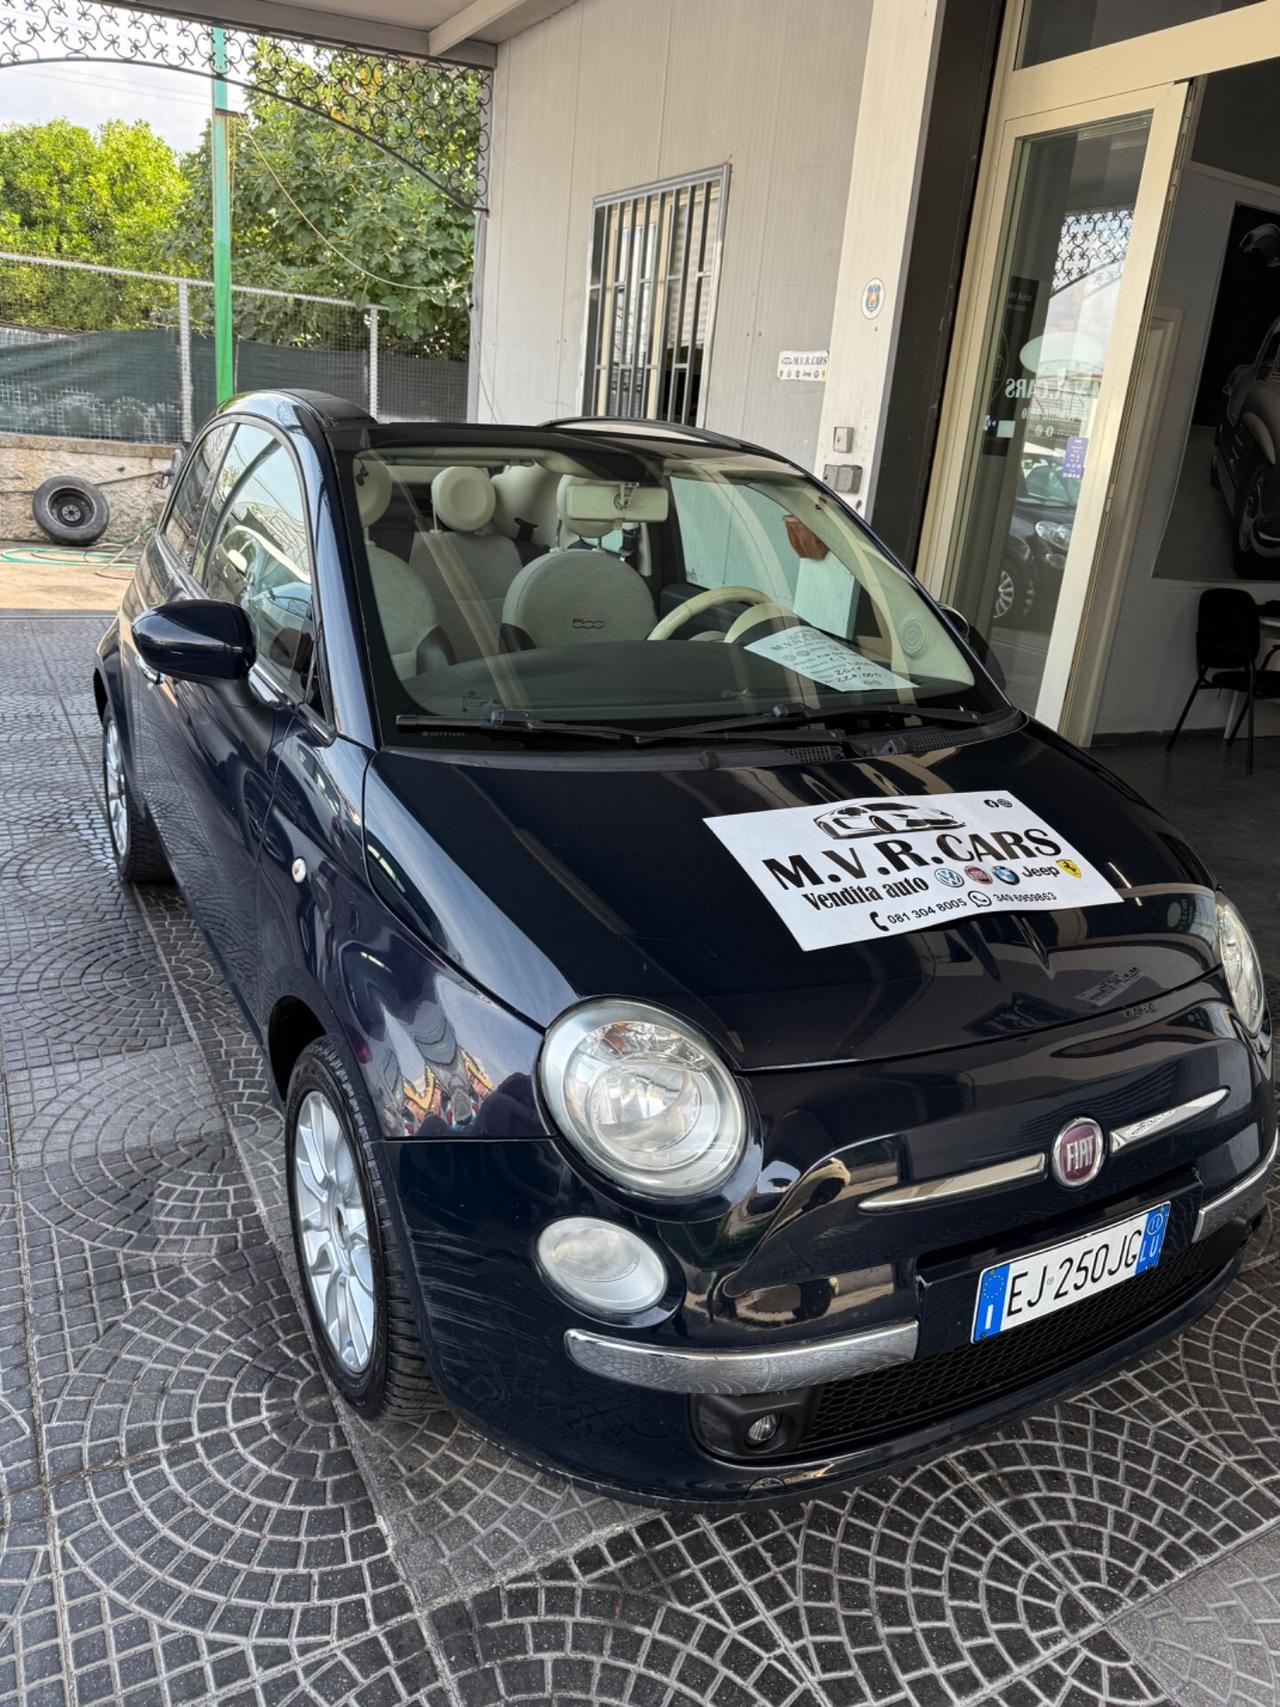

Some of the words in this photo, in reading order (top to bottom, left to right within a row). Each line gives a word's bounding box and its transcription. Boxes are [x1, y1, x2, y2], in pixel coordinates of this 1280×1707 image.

[1021, 865, 1060, 877] Jeep
[801, 885, 883, 911] Vendita
[882, 877, 929, 898] auto
[887, 912, 911, 924] 081
[911, 906, 936, 918] 304
[936, 898, 967, 912] 8005
[1066, 1134, 1095, 1172] FIAT
